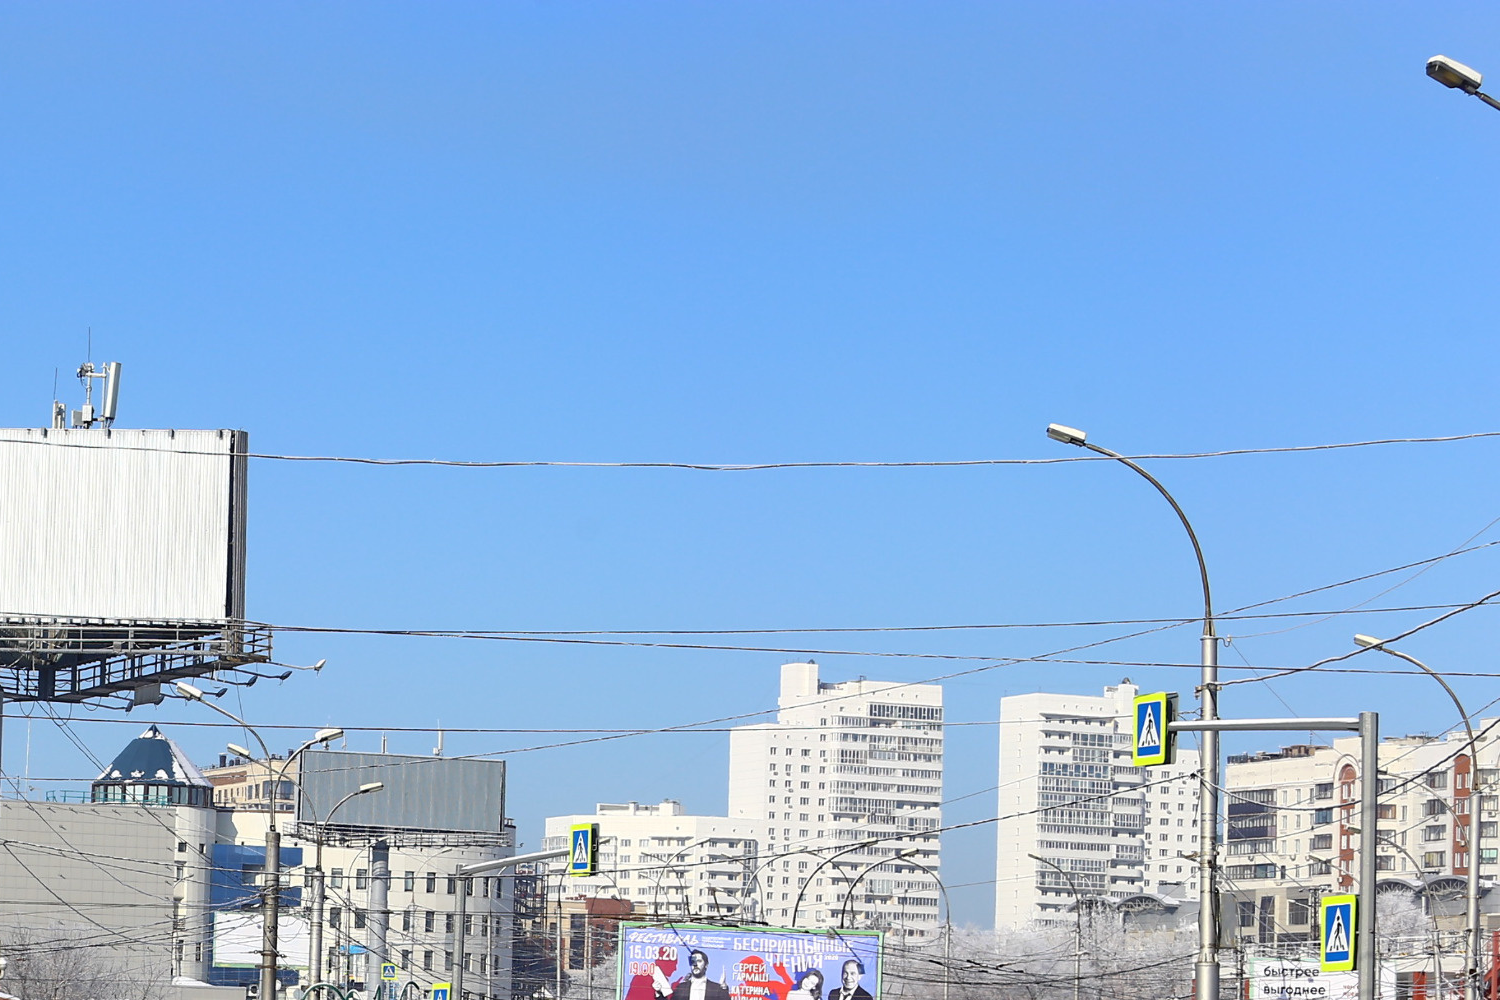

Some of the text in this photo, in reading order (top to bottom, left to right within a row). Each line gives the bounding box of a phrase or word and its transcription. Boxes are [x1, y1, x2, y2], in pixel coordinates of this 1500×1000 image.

[628, 931, 699, 945] ФЕСТИВАЛЬ
[629, 944, 678, 961] 15.03.20
[732, 962, 767, 973] СЕРГЕЙ
[765, 952, 823, 973] ЧТЕНИЯ
[732, 972, 769, 982] ГАРМАШ
[1263, 965, 1320, 979] быстрее
[1263, 985, 1326, 996] выгоднее
